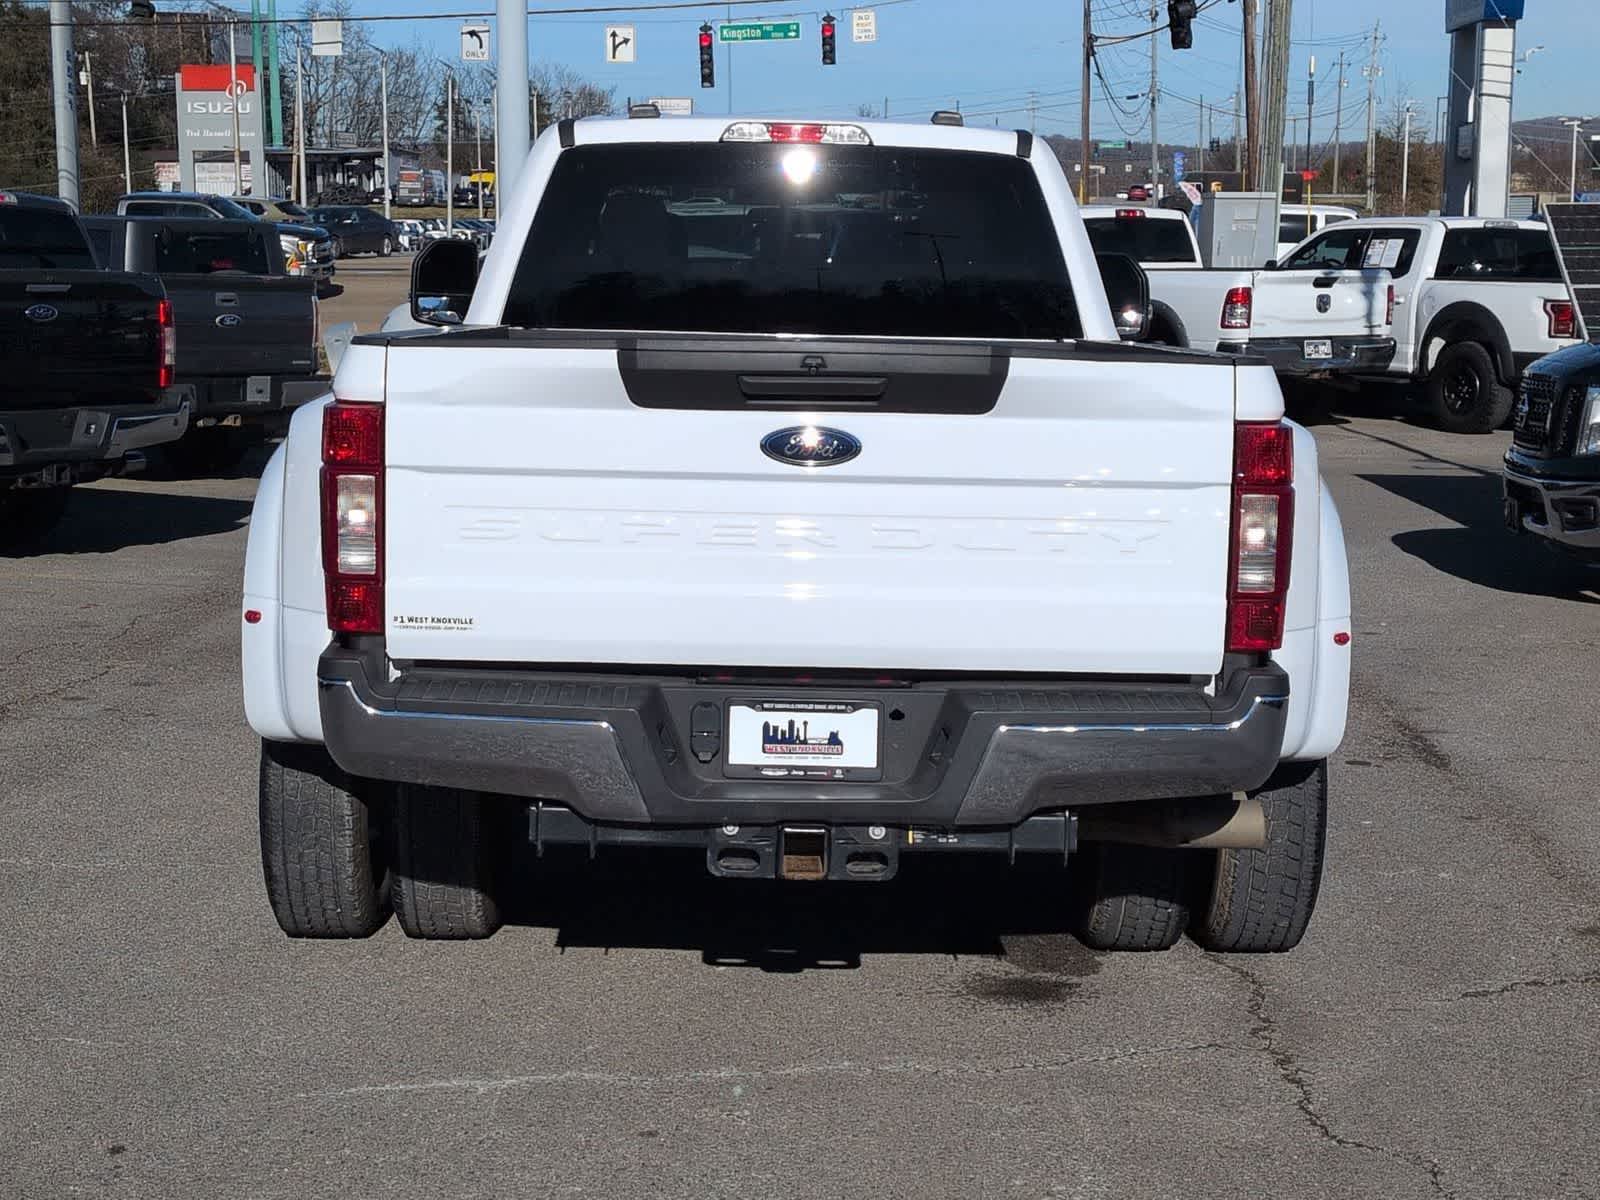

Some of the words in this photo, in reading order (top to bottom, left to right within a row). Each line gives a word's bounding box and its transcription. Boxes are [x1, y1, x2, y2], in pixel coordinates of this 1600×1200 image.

[722, 27, 761, 41] Kingston
[187, 101, 250, 113] ISUZU
[456, 516, 838, 549] SUPER
[872, 522, 1163, 554] DUTY
[407, 616, 428, 624] WEST
[431, 617, 474, 625] KNOXVILLE
